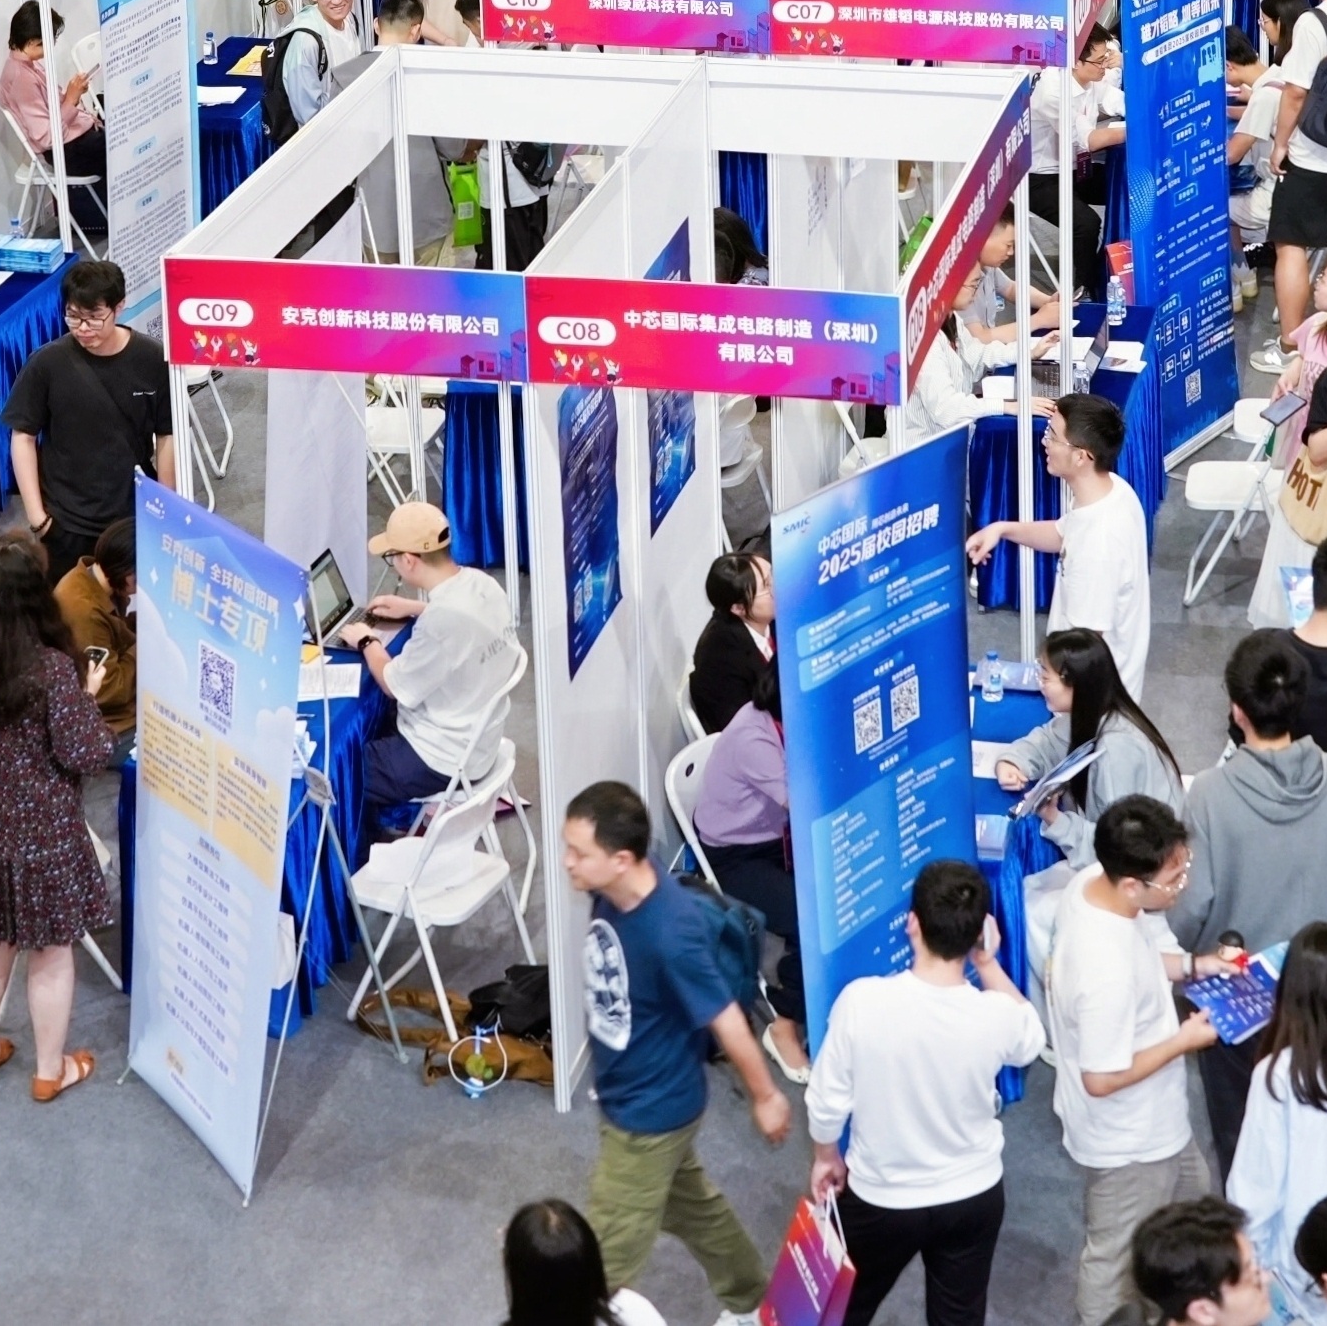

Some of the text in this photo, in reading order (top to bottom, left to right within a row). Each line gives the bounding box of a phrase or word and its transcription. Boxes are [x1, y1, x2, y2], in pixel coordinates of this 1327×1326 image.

[785, 3, 1065, 32] C07 深圳市雄韬电源科技股份有限公司
[1139, 11, 1180, 44] 雄才韬略
[195, 302, 500, 336] C09 安克创新科技股份有限公司
[556, 310, 879, 346] C08 中芯国际集成电路制造（深圳）
[718, 342, 795, 367] 有限公司
[782, 515, 812, 535] SMIC
[818, 515, 868, 556] 中芯国际
[818, 504, 940, 585] 2025届校园招聘
[161, 533, 279, 616] 安克创新 全球校园招聘
[172, 563, 271, 657] 博士专项
